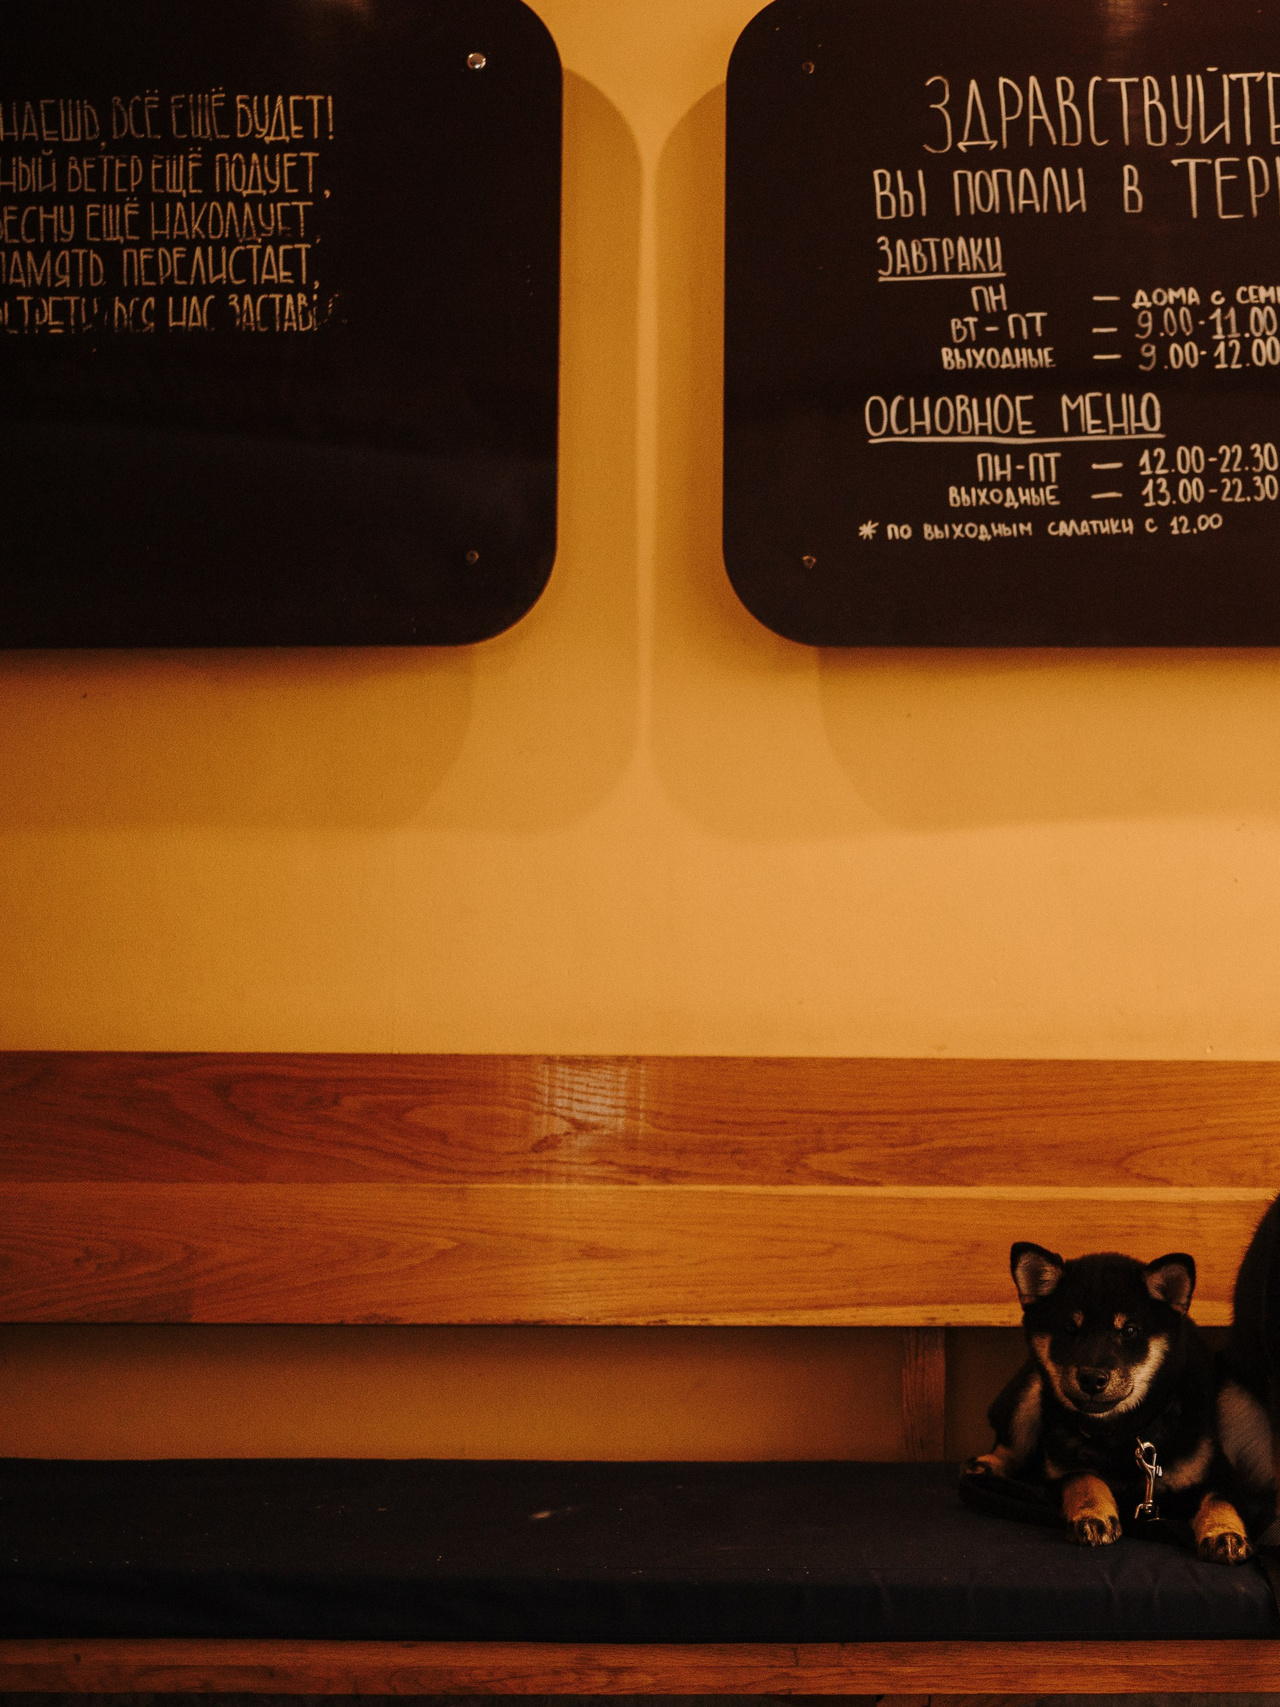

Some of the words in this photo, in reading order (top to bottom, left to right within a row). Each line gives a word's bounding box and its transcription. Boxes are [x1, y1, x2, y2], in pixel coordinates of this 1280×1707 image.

[111, 88, 162, 140] ВСЁ
[169, 85, 231, 141] ЕЩЁ
[234, 93, 335, 145] БУДЕТ!
[67, 154, 144, 193] ВЕТЕР
[150, 146, 204, 198] ЕЩЁ
[214, 150, 332, 200] ПОДУЕТ,
[872, 167, 927, 221] ВЫ
[952, 166, 1088, 217] ПОПАЛИ
[1122, 163, 1144, 214] В
[85, 196, 141, 245] ЕЩЁ
[121, 242, 321, 291] ПЕРЕЛИСТАЕТ,
[876, 235, 1006, 275] ЗАВТРАКИ
[167, 293, 216, 332] НАС
[970, 282, 1008, 314] ПН
[1130, 286, 1201, 310] ДОМА
[940, 346, 1057, 371] ВЫХОДНЫЕ
[863, 392, 1037, 437] ОСНОВНОЕ
[1060, 390, 1163, 436] МЕНЮ
[976, 451, 1062, 484] ПН-ПТ
[1138, 441, 1280, 475] 12.00-22.30
[947, 483, 1061, 510] ВЫХОДНЫЕ
[1140, 474, 1280, 508] 13.00-22.30
[885, 522, 913, 541] ПО
[922, 521, 1034, 542] ВЫХОДНЫМ
[1046, 517, 1135, 538] САЛАТИКИ
[1144, 517, 1159, 534] С
